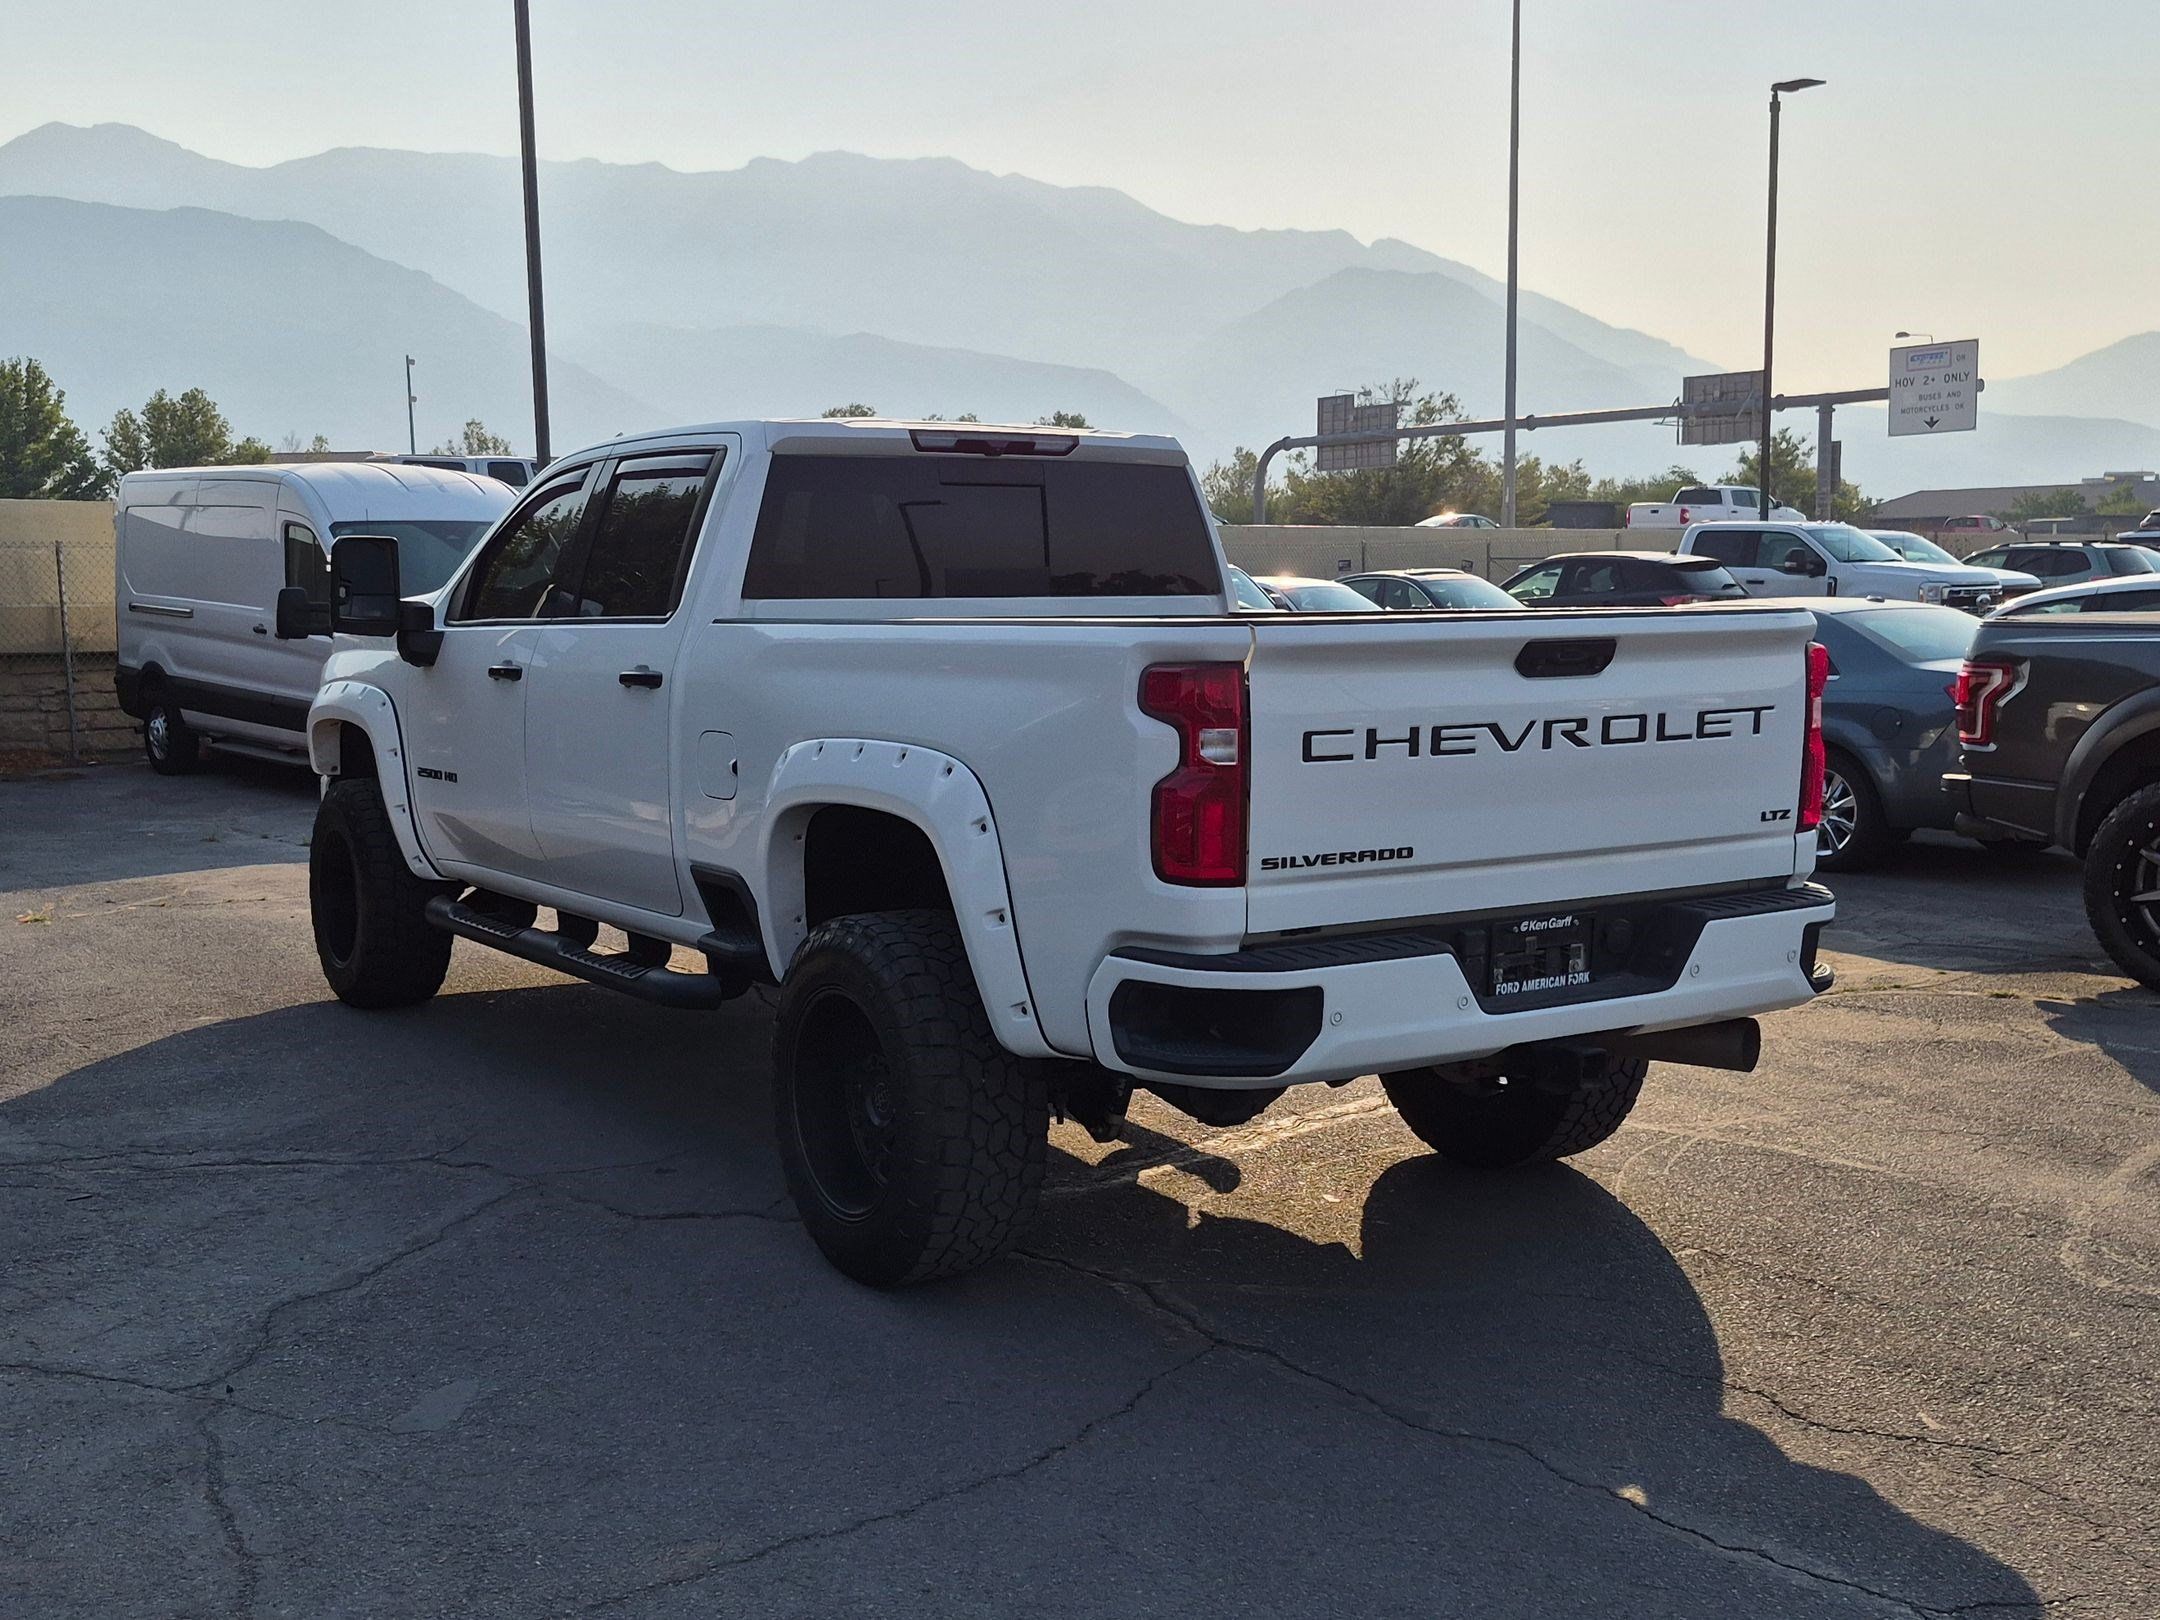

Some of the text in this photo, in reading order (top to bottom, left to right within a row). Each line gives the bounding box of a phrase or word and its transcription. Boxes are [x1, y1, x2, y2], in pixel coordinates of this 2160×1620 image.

[1895, 377, 1916, 388] HOV
[1944, 371, 1970, 384] ONLY
[1919, 391, 1961, 401] BUSES AND
[1901, 404, 1949, 415] MOTORCYCLES
[1302, 706, 1775, 762] CHEVROLET
[417, 767, 457, 783] 2500 HD
[1760, 808, 1792, 822] LTZ
[1260, 846, 1414, 871] SILVERADO
[1529, 915, 1573, 931] Ken Garff
[1496, 971, 1590, 996] FORD AMERICAN FORK
